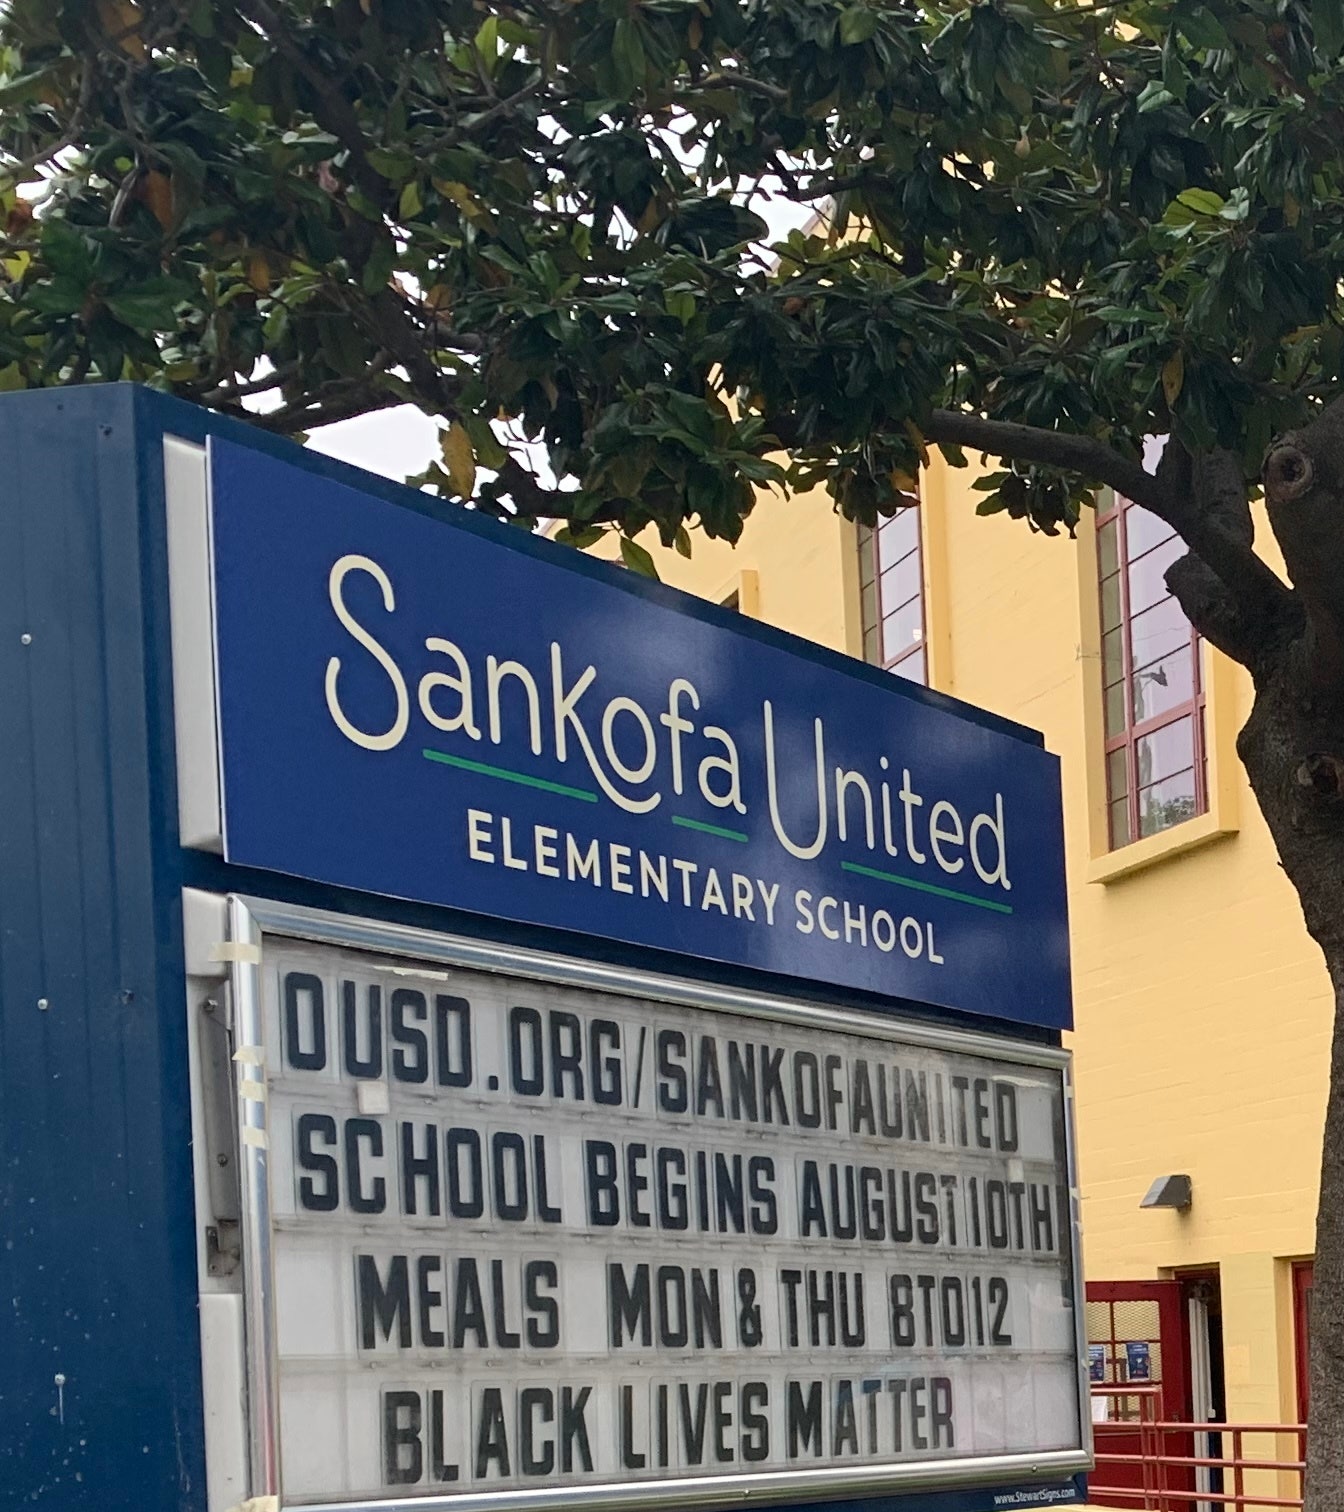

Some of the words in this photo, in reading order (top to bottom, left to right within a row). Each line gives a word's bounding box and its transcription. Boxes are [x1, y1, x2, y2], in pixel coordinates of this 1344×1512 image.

[325, 554, 747, 814] Sankofa
[764, 700, 1011, 891] United
[467, 808, 780, 926] ELEMENTARY
[795, 889, 944, 965] SCHOOL
[298, 1113, 562, 1223] SCHOOL
[586, 1140, 778, 1234] BEGINS
[358, 1254, 560, 1349] MEALS
[610, 1263, 722, 1348] MON
[738, 1268, 763, 1347] &
[781, 1269, 866, 1347] THU
[384, 1386, 594, 1485] BLACK
[622, 1381, 769, 1468] LIVES
[789, 1377, 954, 1457] MATTER
[994, 1488, 1075, 1504] www.StewartSigns.com
